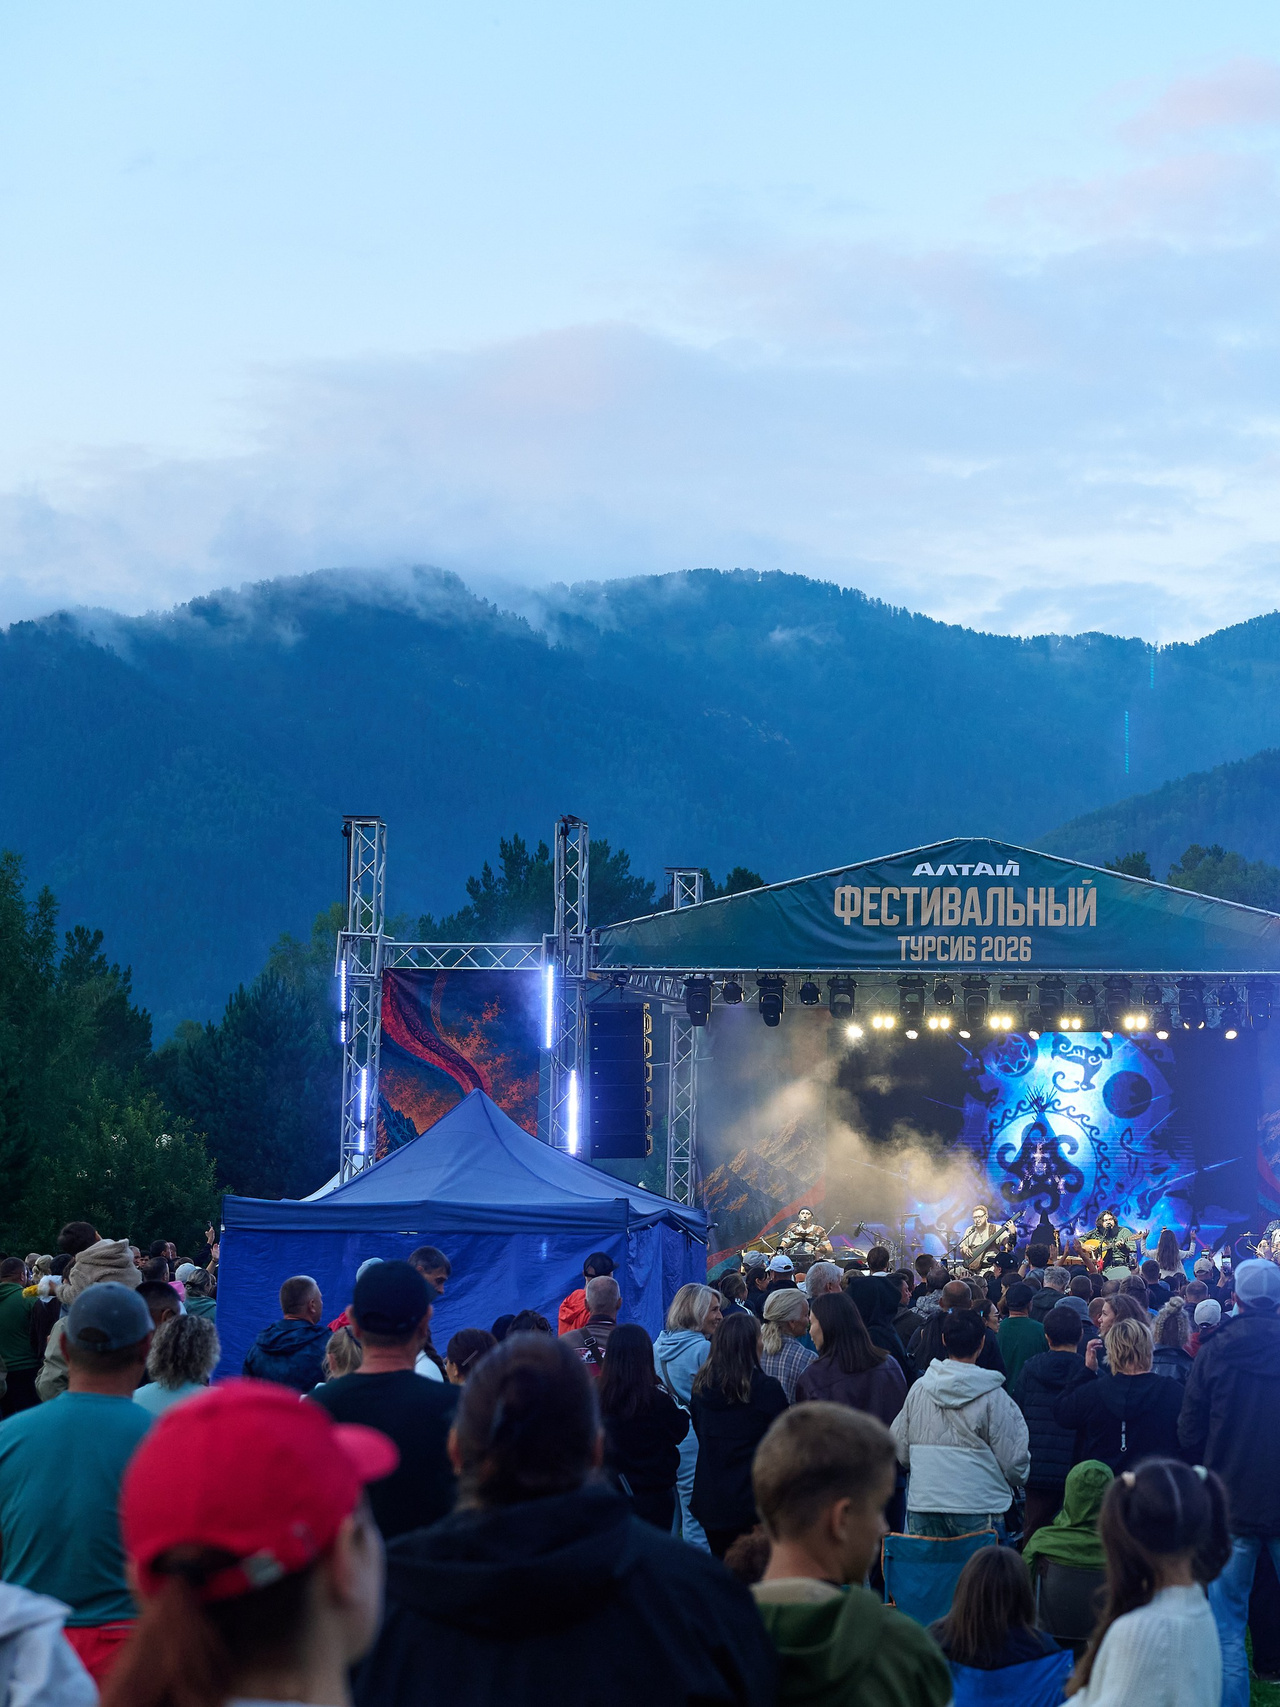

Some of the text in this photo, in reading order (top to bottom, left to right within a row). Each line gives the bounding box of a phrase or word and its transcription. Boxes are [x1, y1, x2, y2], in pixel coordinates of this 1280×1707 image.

[911, 859, 1020, 877] АЛТАЙ
[833, 879, 1097, 927] ФЕСТИВАЛЬНЫЙ
[897, 935, 1032, 962] ТУРСИБ 2026
